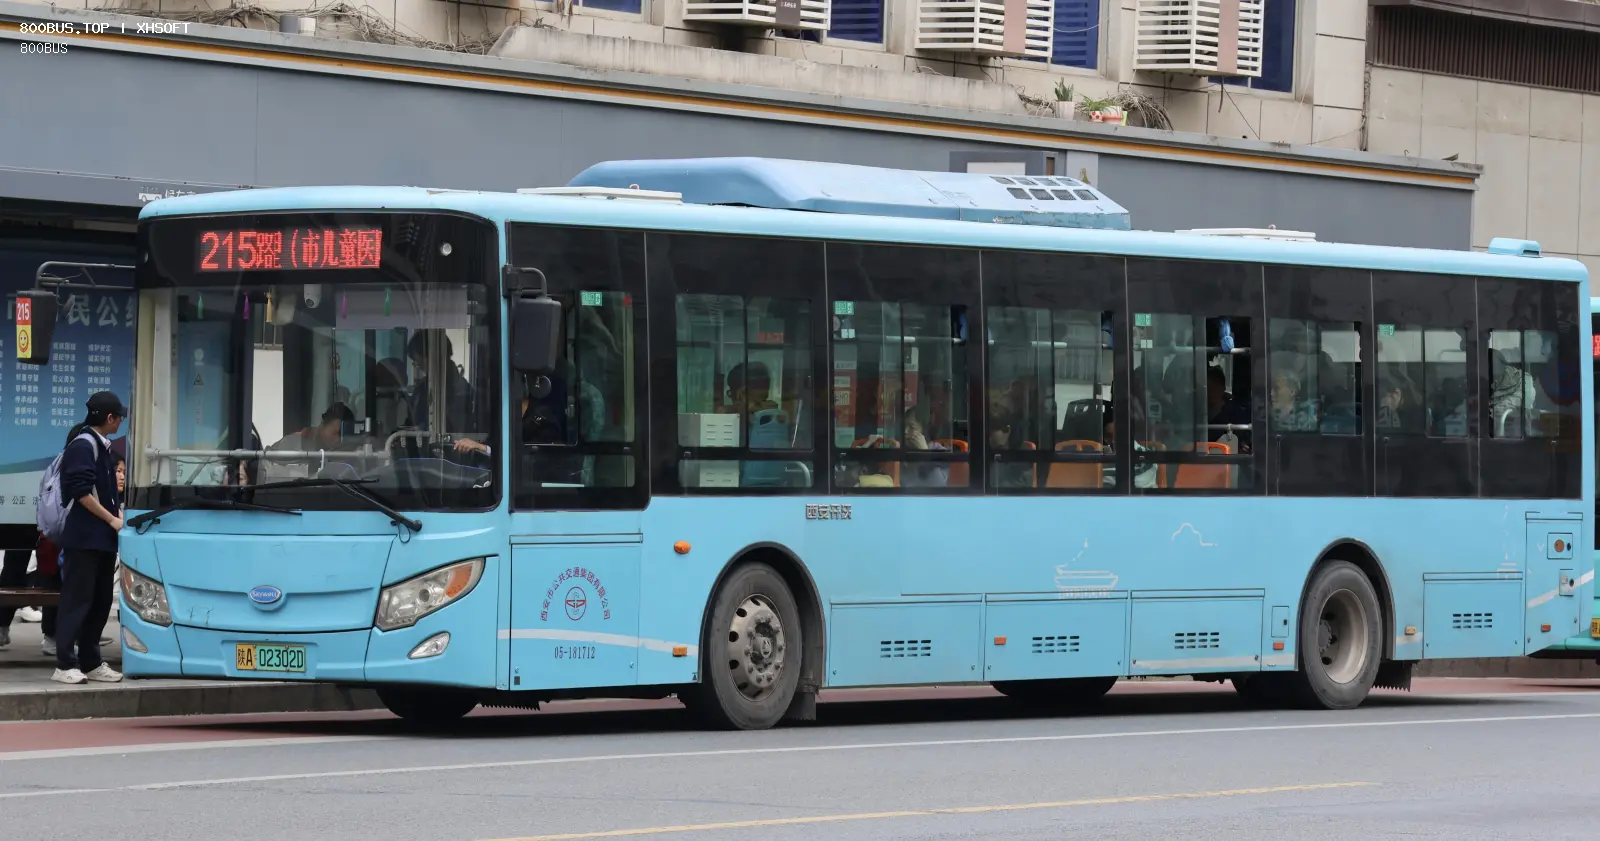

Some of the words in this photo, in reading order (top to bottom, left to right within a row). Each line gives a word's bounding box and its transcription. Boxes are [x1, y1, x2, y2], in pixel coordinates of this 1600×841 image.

[17, 302, 30, 321] 215
[12, 495, 26, 505] 公正
[540, 567, 611, 622] 西安市公共交通集团有限公司
[554, 646, 596, 659] 05-181712
